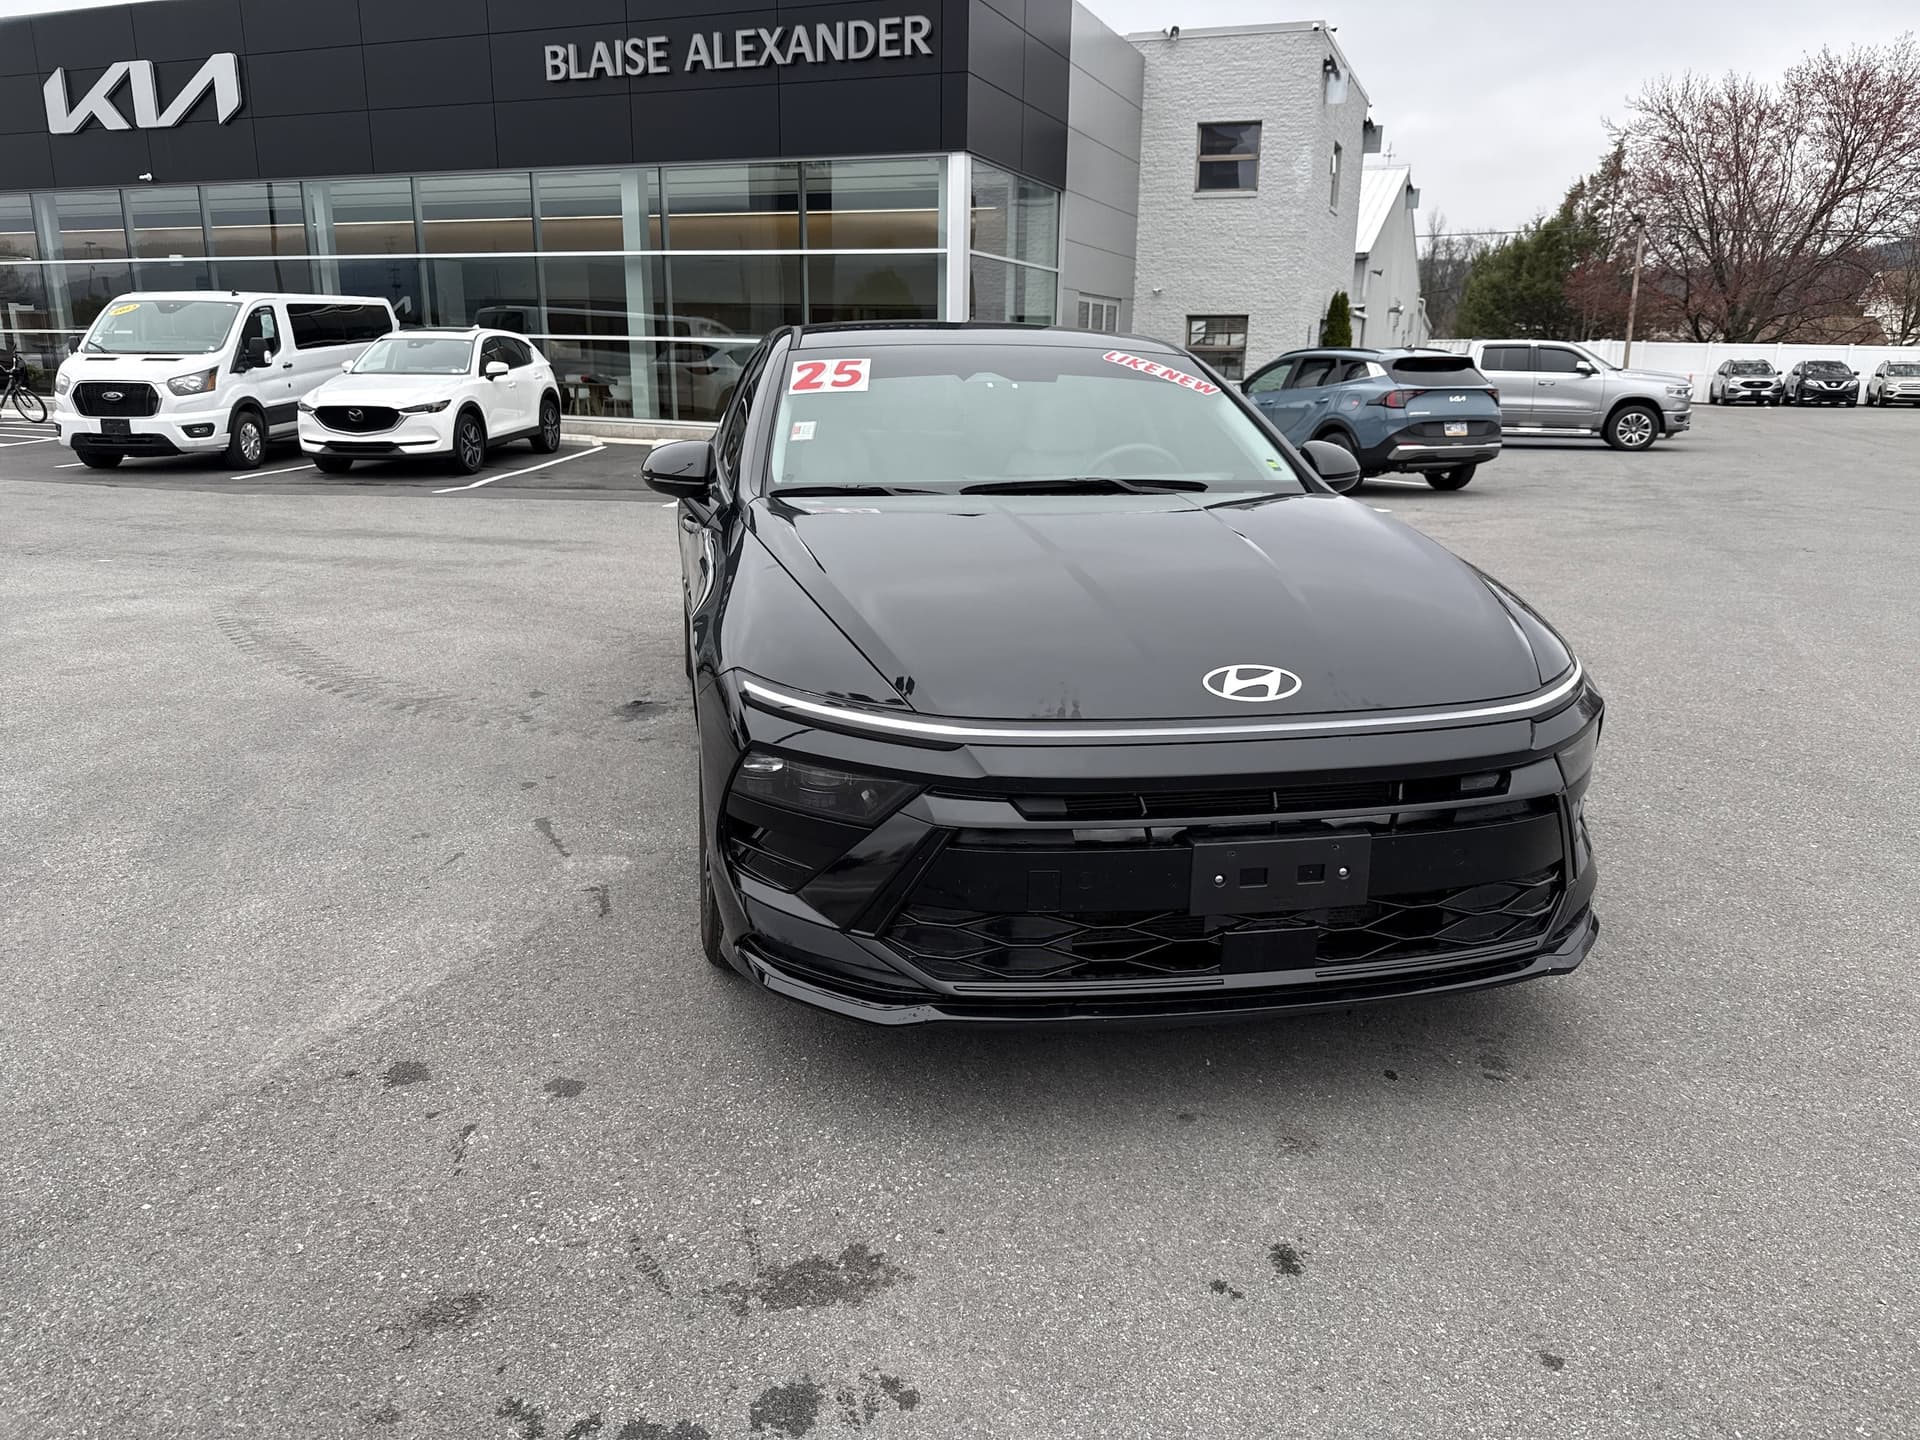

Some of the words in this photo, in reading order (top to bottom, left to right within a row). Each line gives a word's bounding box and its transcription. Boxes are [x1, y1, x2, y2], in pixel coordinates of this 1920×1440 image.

[544, 36, 670, 81] BLAISE
[684, 15, 933, 71] ALEXANDER
[43, 52, 242, 134] KIA
[792, 360, 862, 391] 25
[1104, 352, 1162, 373] LIKE
[1160, 369, 1218, 394] NEW
